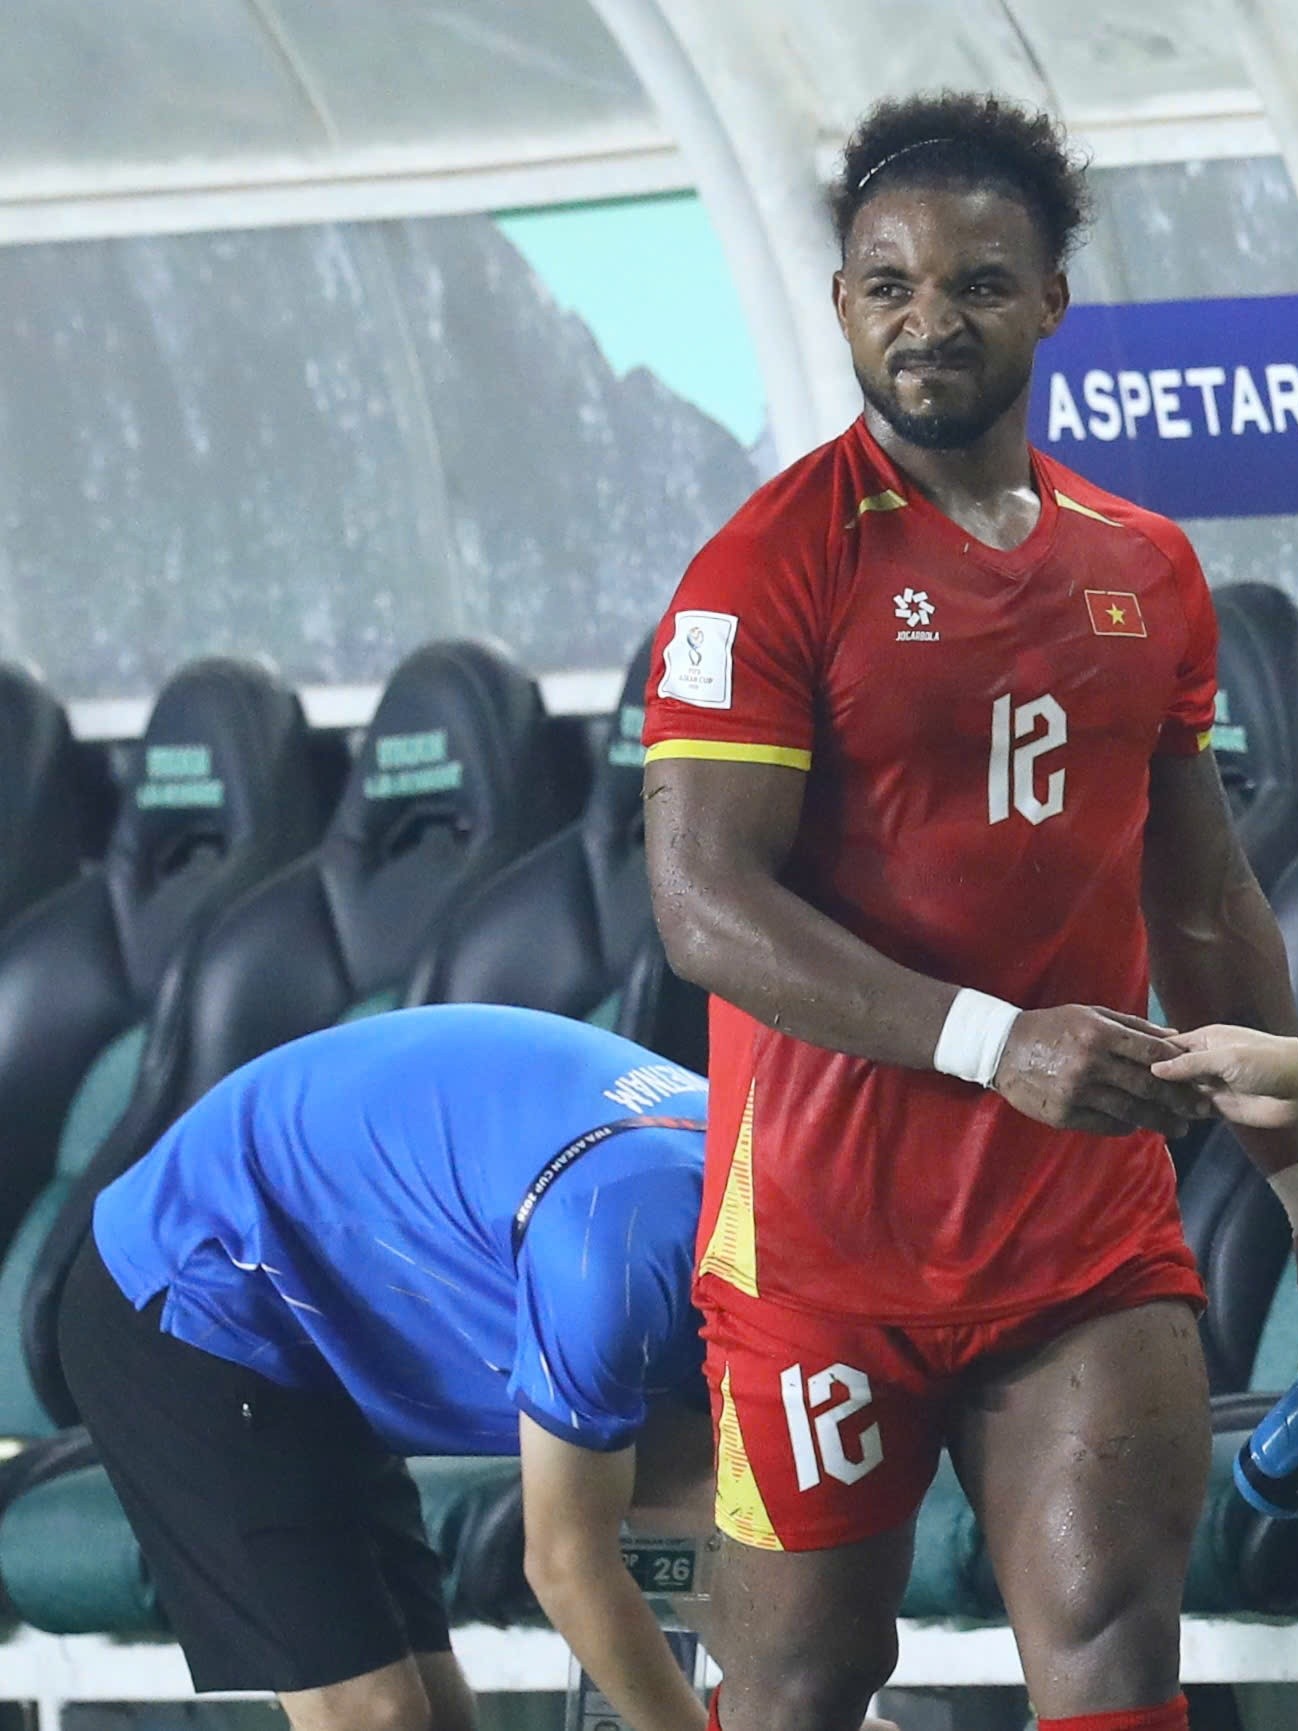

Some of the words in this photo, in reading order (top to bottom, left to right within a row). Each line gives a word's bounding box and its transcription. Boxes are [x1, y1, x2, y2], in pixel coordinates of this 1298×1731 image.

[988, 692, 1068, 826] 12
[551, 1140, 587, 1171] ASEAN
[535, 1169, 555, 1194] CUP
[780, 1363, 884, 1493] 12
[653, 1557, 691, 1581] 26
